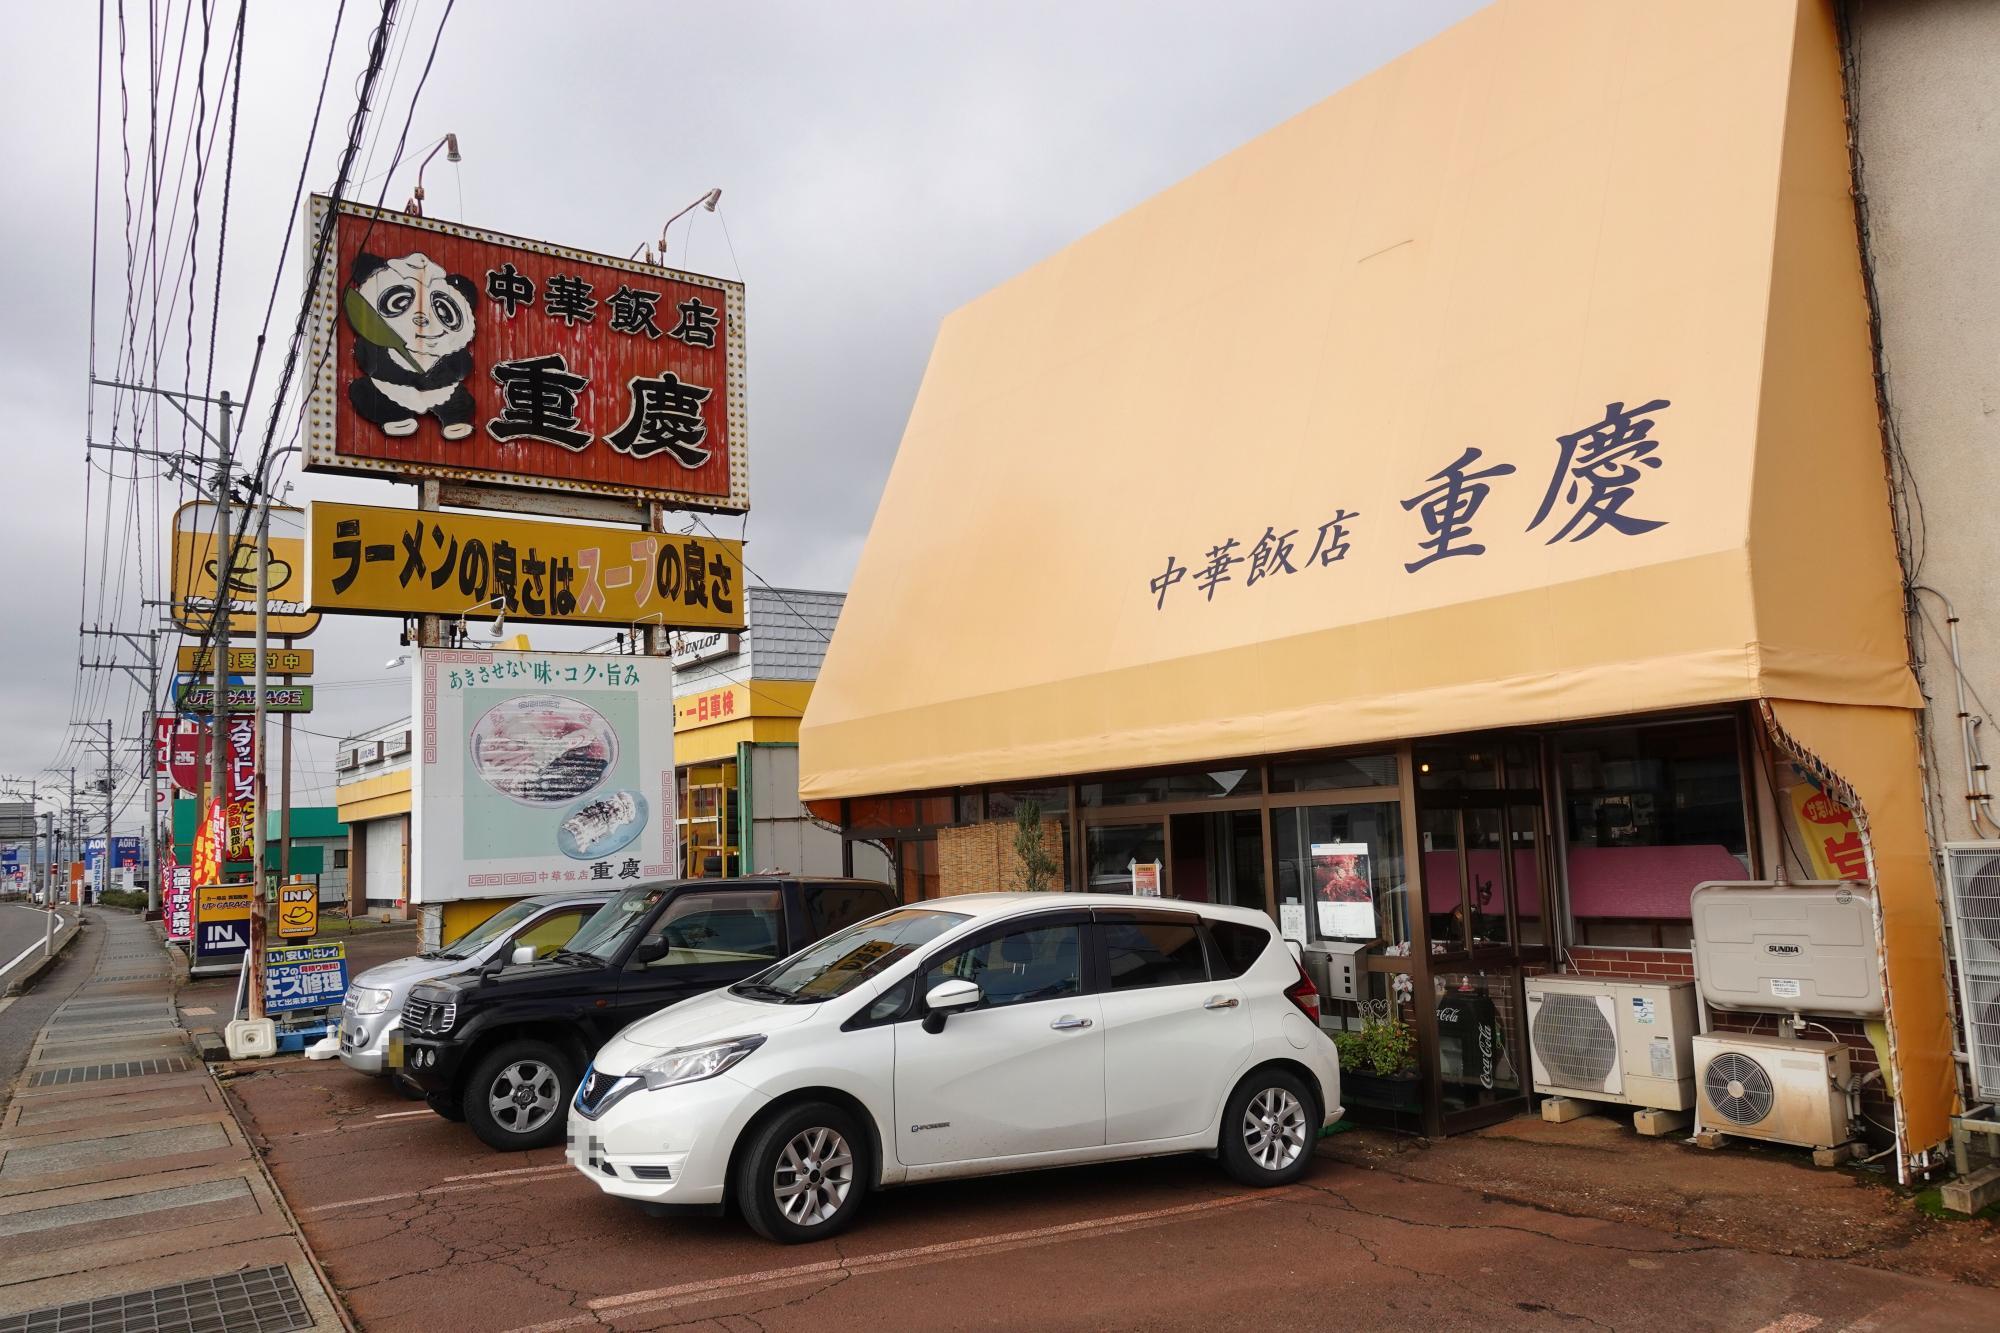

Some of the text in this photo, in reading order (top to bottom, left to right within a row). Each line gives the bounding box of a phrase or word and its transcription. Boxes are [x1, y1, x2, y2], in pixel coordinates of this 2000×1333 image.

[485, 263, 720, 349] 中華飯店
[485, 352, 713, 469] 重慶
[1399, 399, 1671, 574] 重慶
[331, 519, 734, 616] ラーメンの良さはスープの良さ
[1149, 509, 1361, 611] 中華飯店
[185, 596, 257, 614] Yeow
[686, 690, 734, 721] 一日車検
[231, 719, 256, 801] スタッドレス
[88, 839, 106, 849] AOK
[118, 838, 136, 848] AOKI
[538, 857, 642, 883] 中華飯店 重慶
[283, 890, 303, 902] IN
[207, 925, 232, 942] IN
[1768, 945, 1799, 953] SUNDIA
[266, 972, 343, 998] キズ修理
[266, 995, 318, 1008] 店で出来ます!
